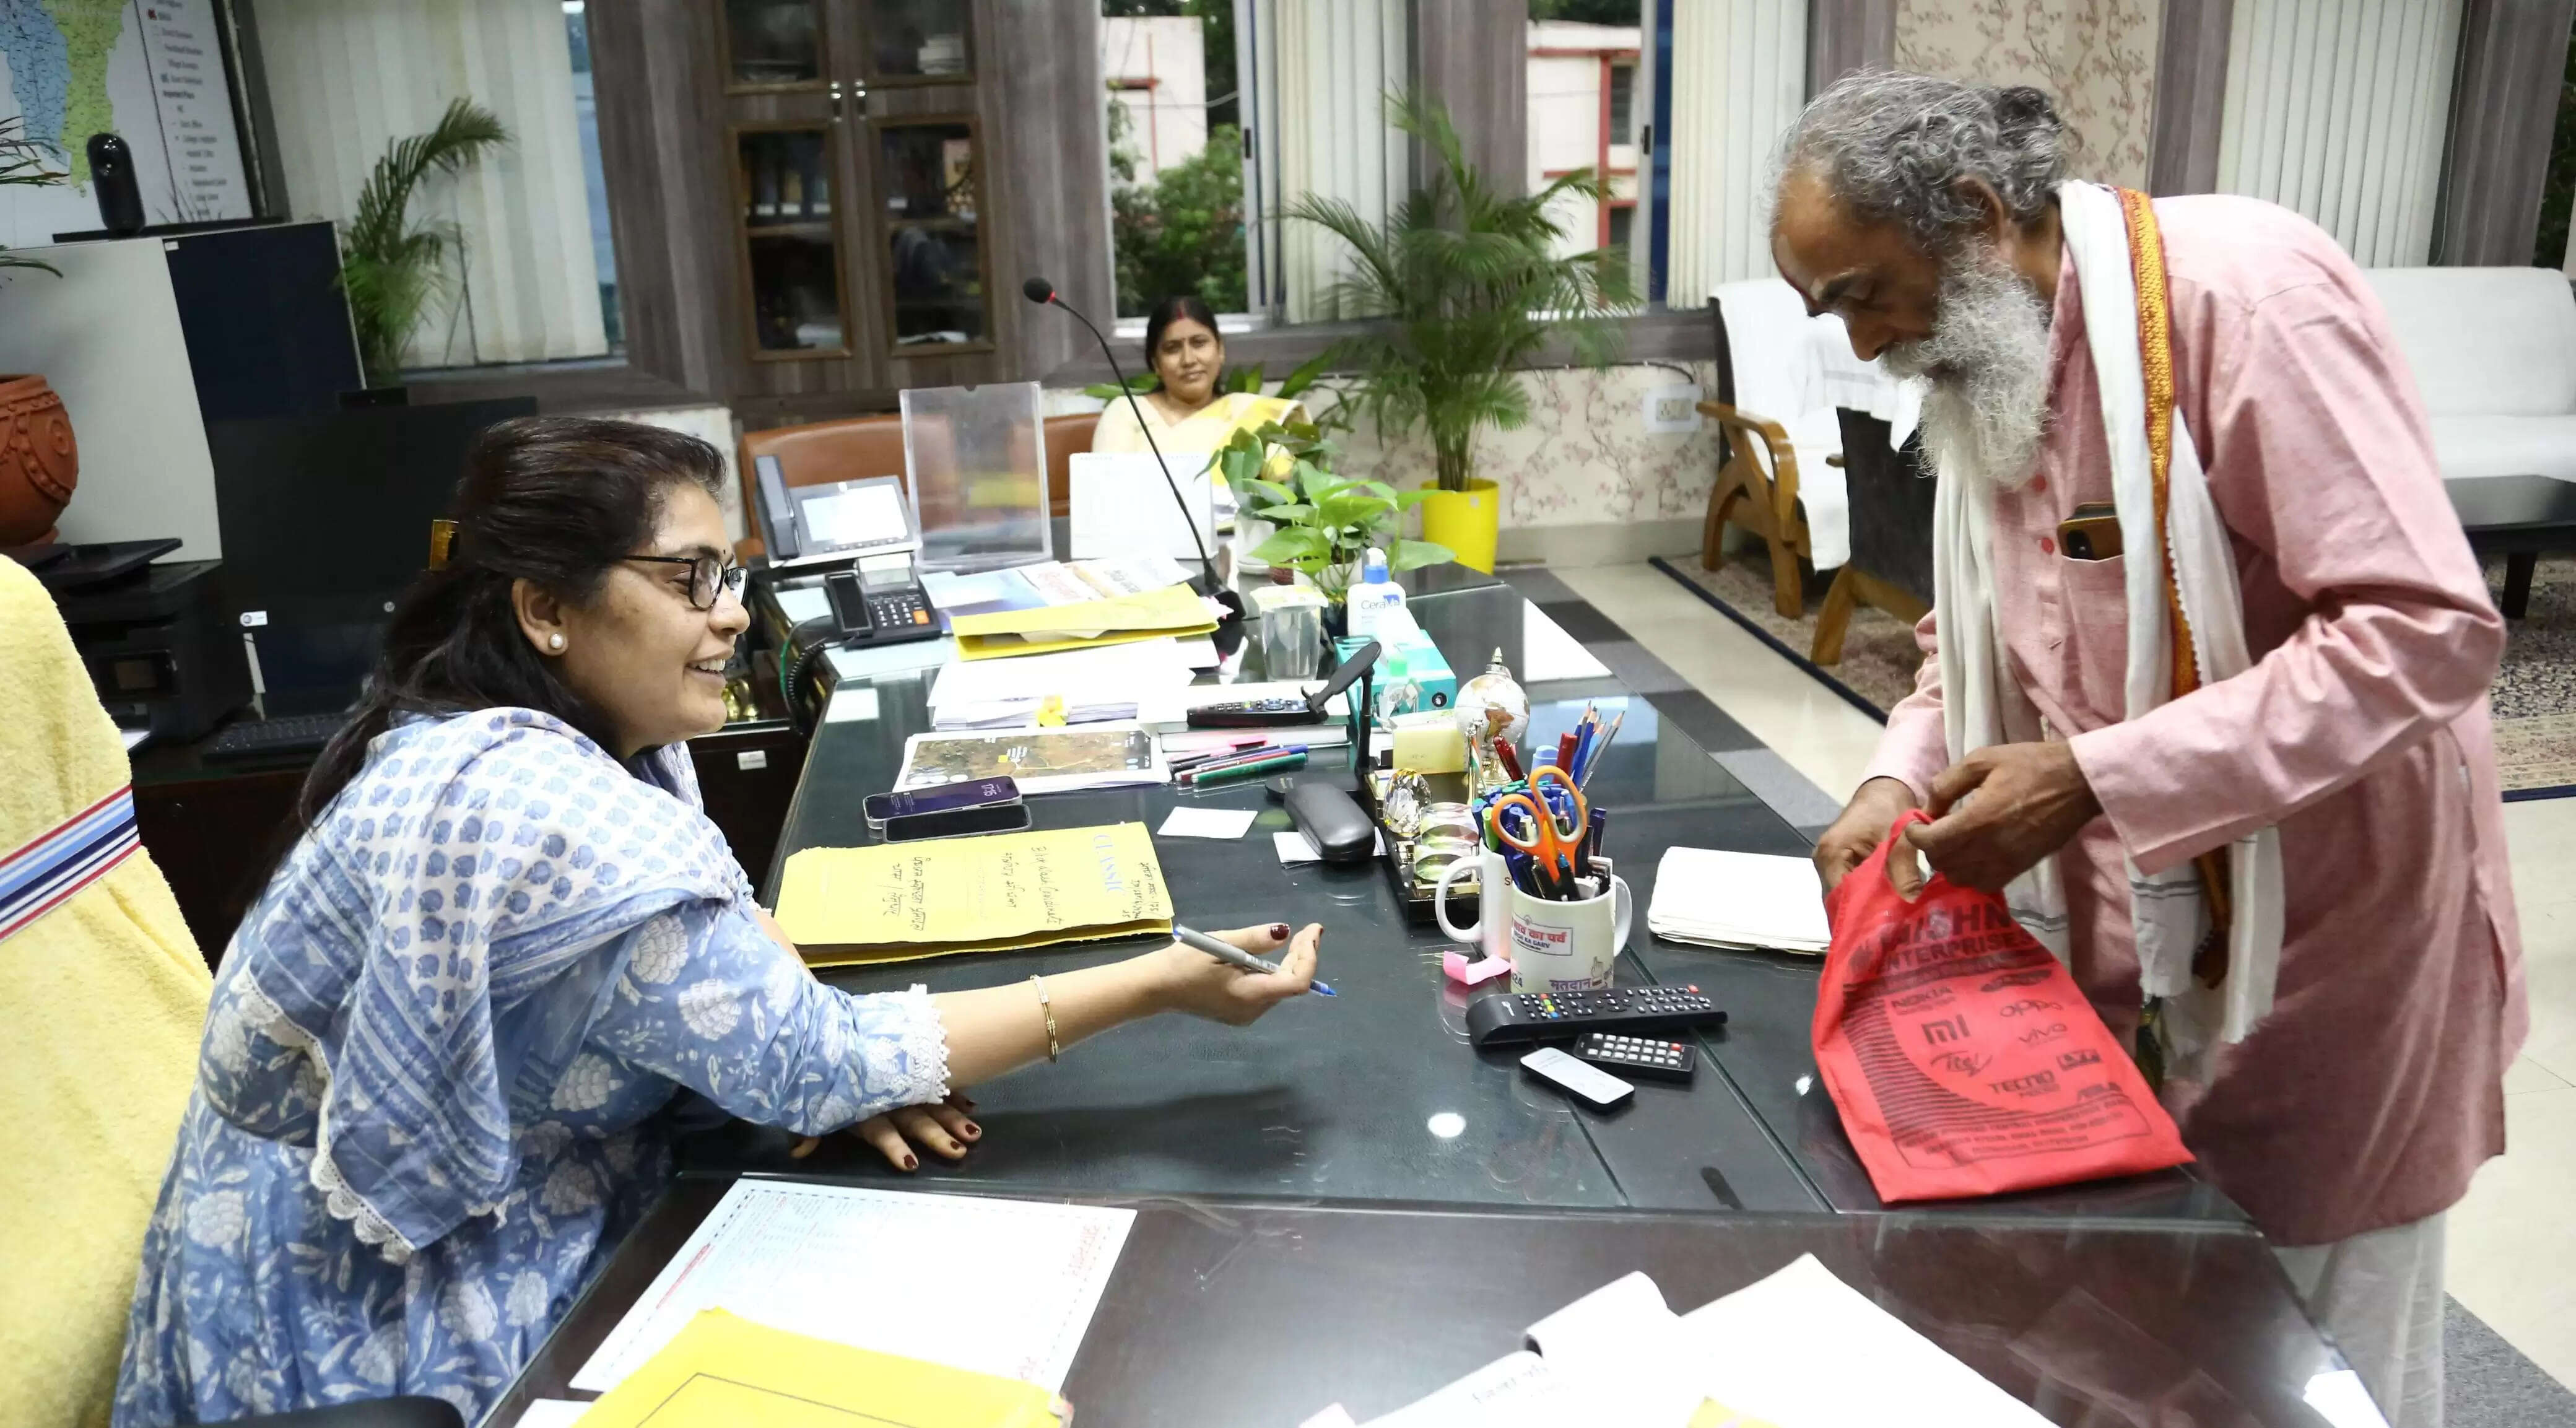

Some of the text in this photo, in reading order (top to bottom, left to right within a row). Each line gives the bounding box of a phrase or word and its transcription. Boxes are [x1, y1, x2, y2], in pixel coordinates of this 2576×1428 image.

[1094, 834, 1126, 896] CLASSIC
[1528, 928, 1544, 941] का
[1549, 977, 1591, 992] मतदान
[1891, 986, 1953, 1008] NOKIA
[1987, 1069, 2055, 1093] TECNO
